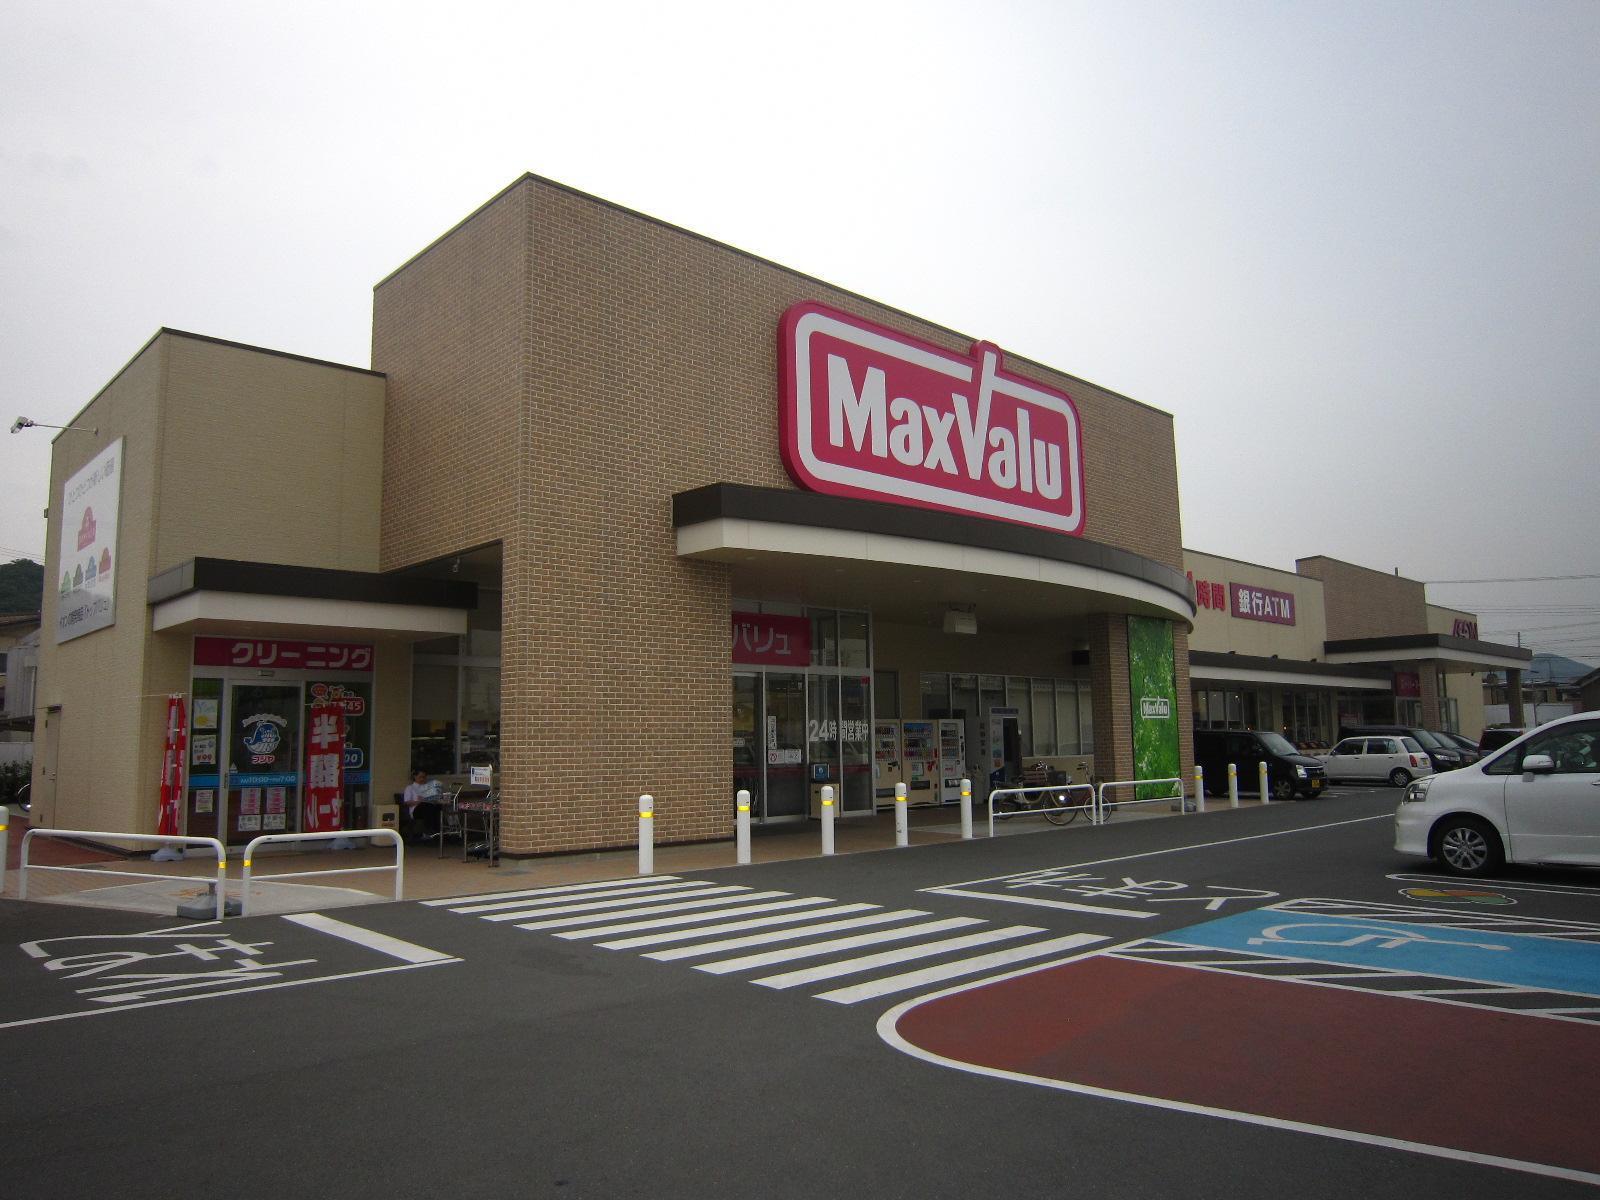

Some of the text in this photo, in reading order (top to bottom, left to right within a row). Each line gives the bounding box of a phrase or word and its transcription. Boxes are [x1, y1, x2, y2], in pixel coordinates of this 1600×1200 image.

[827, 351, 1062, 499] MaxValu
[1187, 571, 1225, 611] 時間
[1239, 588, 1290, 618] 銀行ATM
[232, 642, 371, 668] クリーニング
